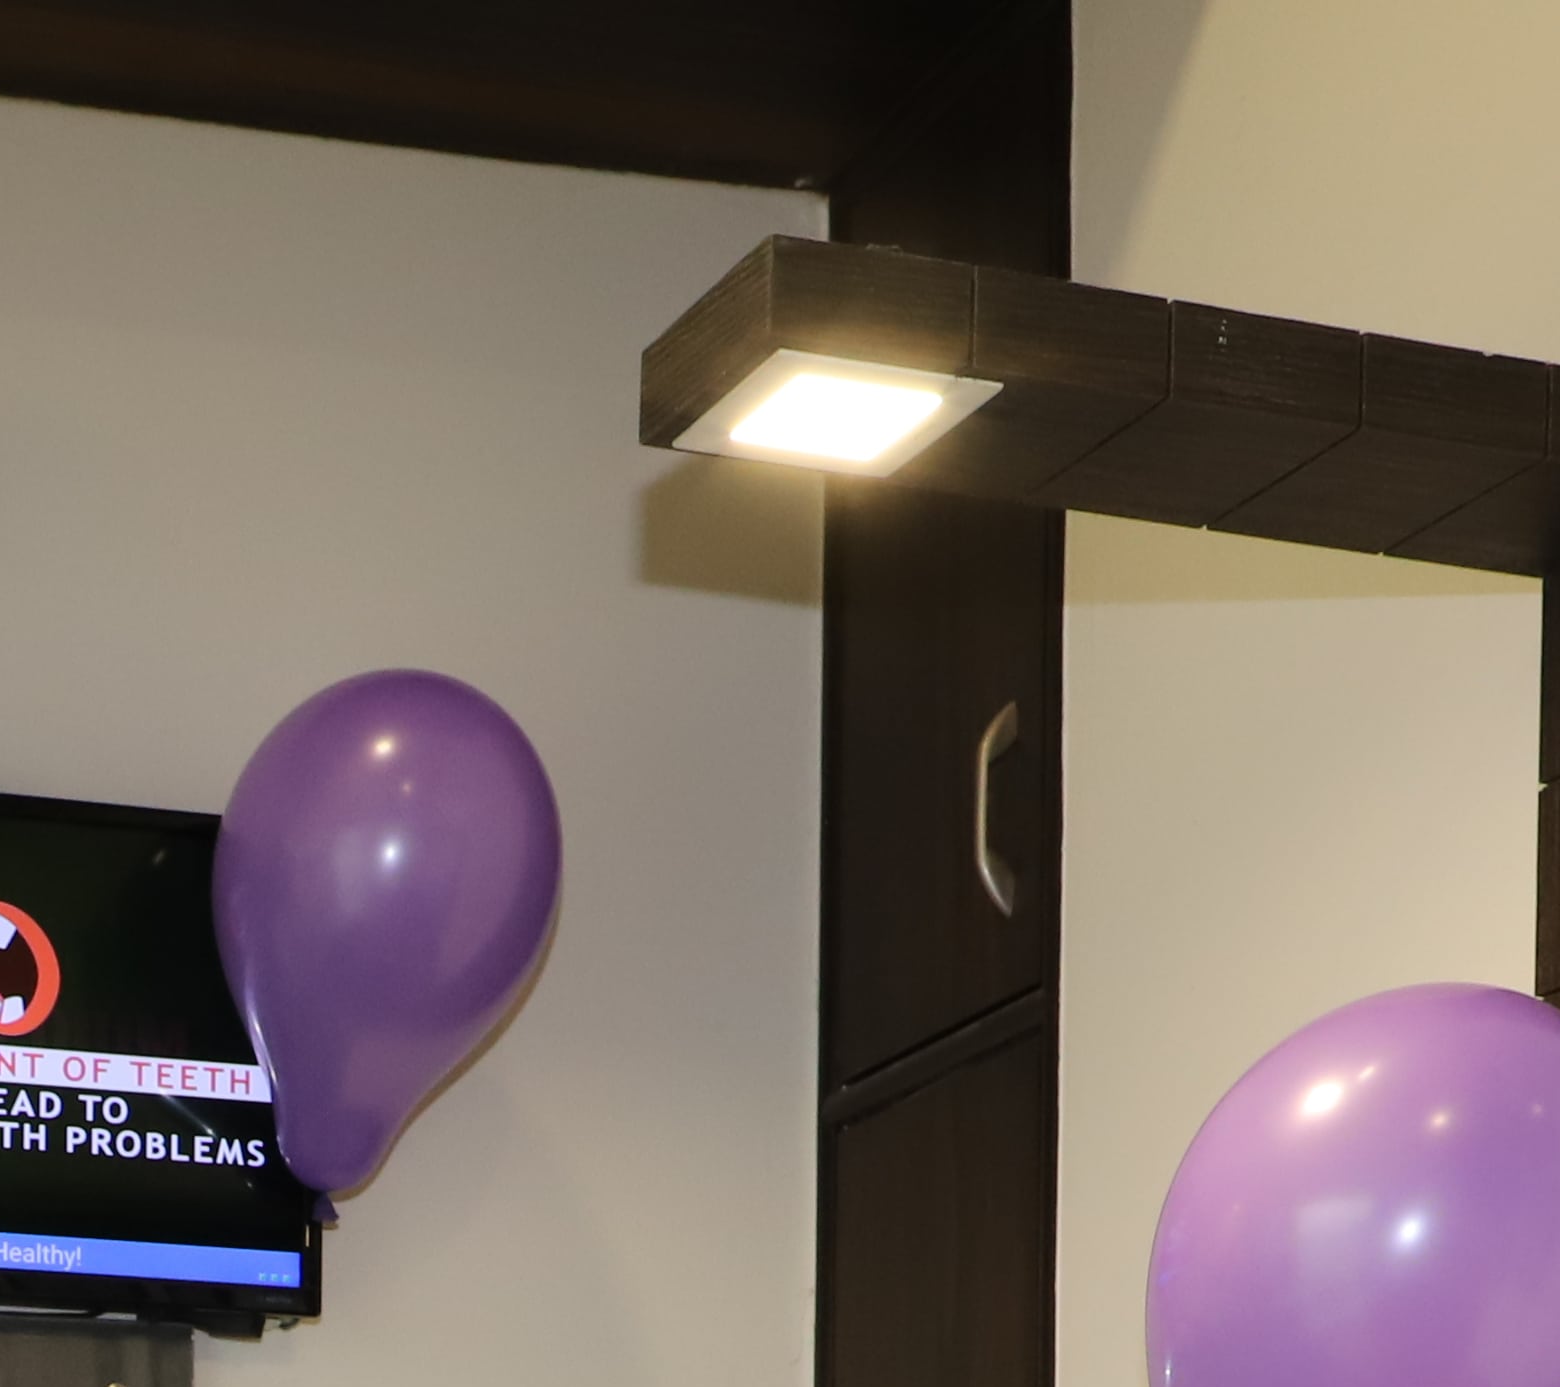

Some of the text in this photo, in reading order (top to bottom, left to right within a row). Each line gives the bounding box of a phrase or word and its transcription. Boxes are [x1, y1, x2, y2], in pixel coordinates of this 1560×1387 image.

[62, 1055, 111, 1084] OF
[130, 1060, 252, 1096] TEETH
[78, 1093, 129, 1125] TO
[66, 1125, 266, 1168] PROBLEMS
